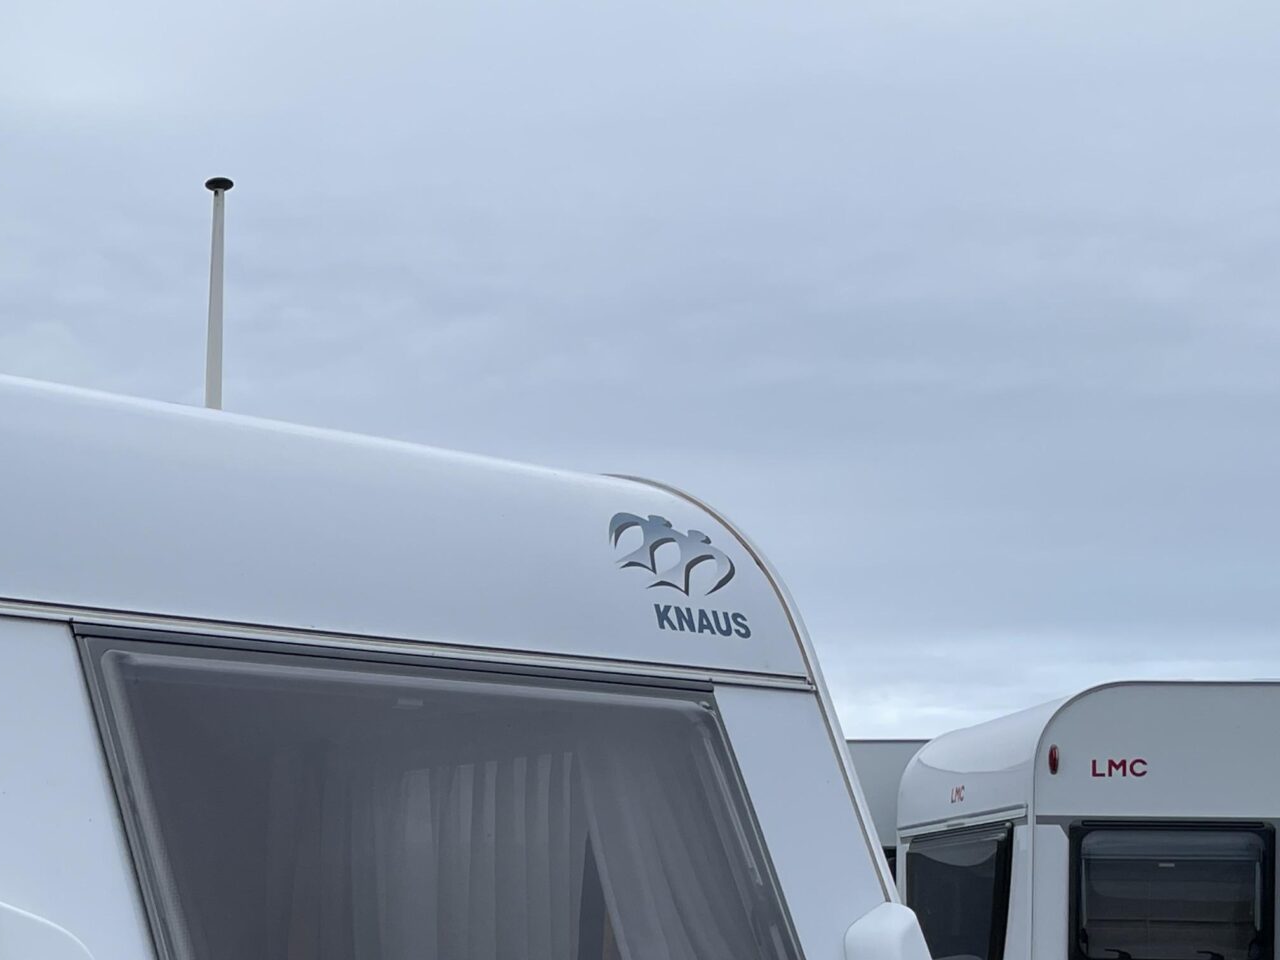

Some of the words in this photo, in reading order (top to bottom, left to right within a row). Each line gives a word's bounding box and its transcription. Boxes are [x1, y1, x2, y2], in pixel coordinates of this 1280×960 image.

[654, 603, 752, 639] KNAUS
[1091, 759, 1148, 778] LMC
[950, 785, 965, 804] LMC
